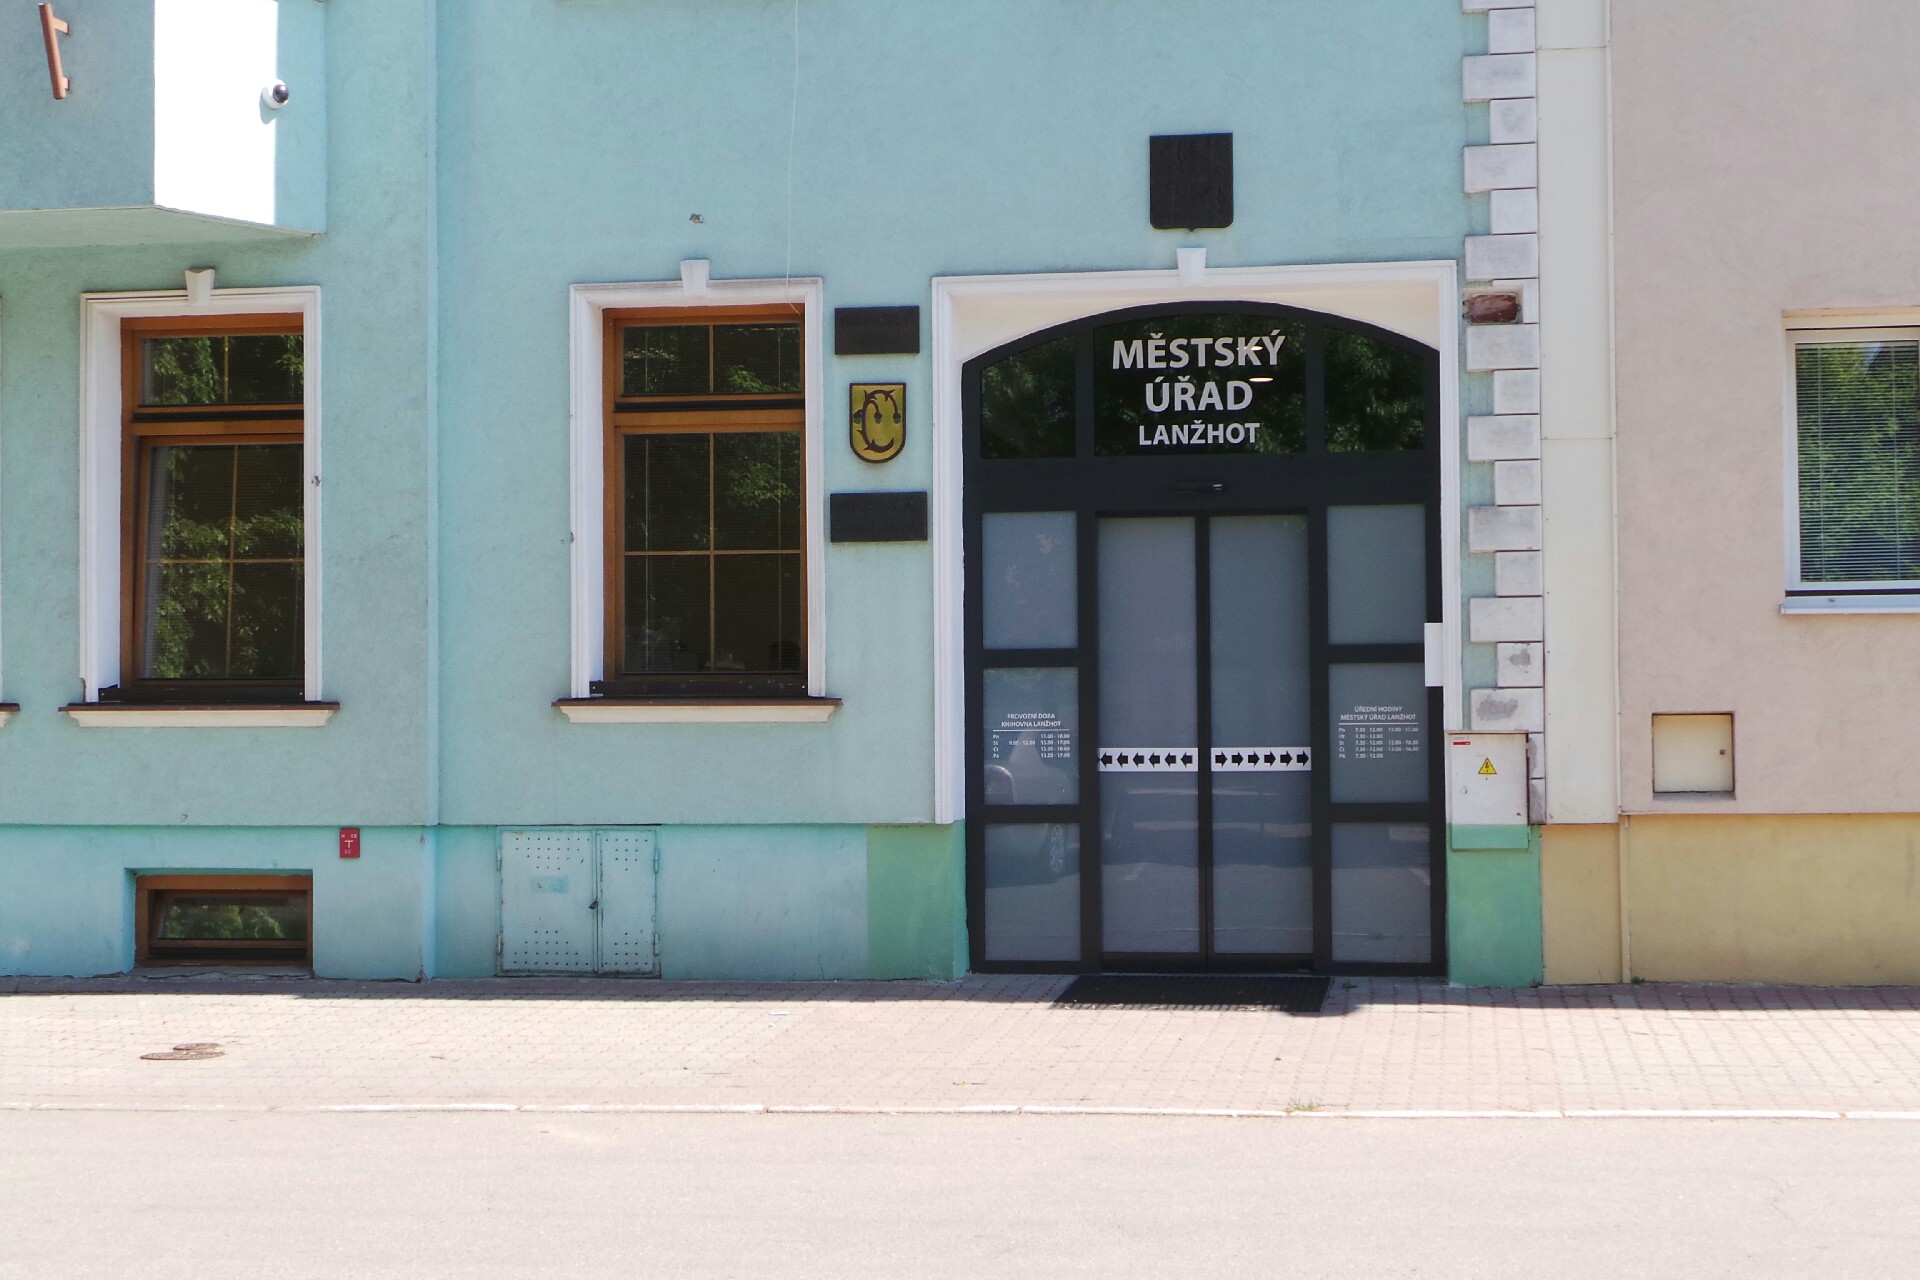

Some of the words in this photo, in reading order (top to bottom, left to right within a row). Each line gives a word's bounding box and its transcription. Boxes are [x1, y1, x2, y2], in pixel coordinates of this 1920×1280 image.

[1112, 329, 1286, 370] MĚSTSKÝ
[1145, 375, 1253, 413] ÚŘAD
[1139, 419, 1261, 446] LANŽHOT
